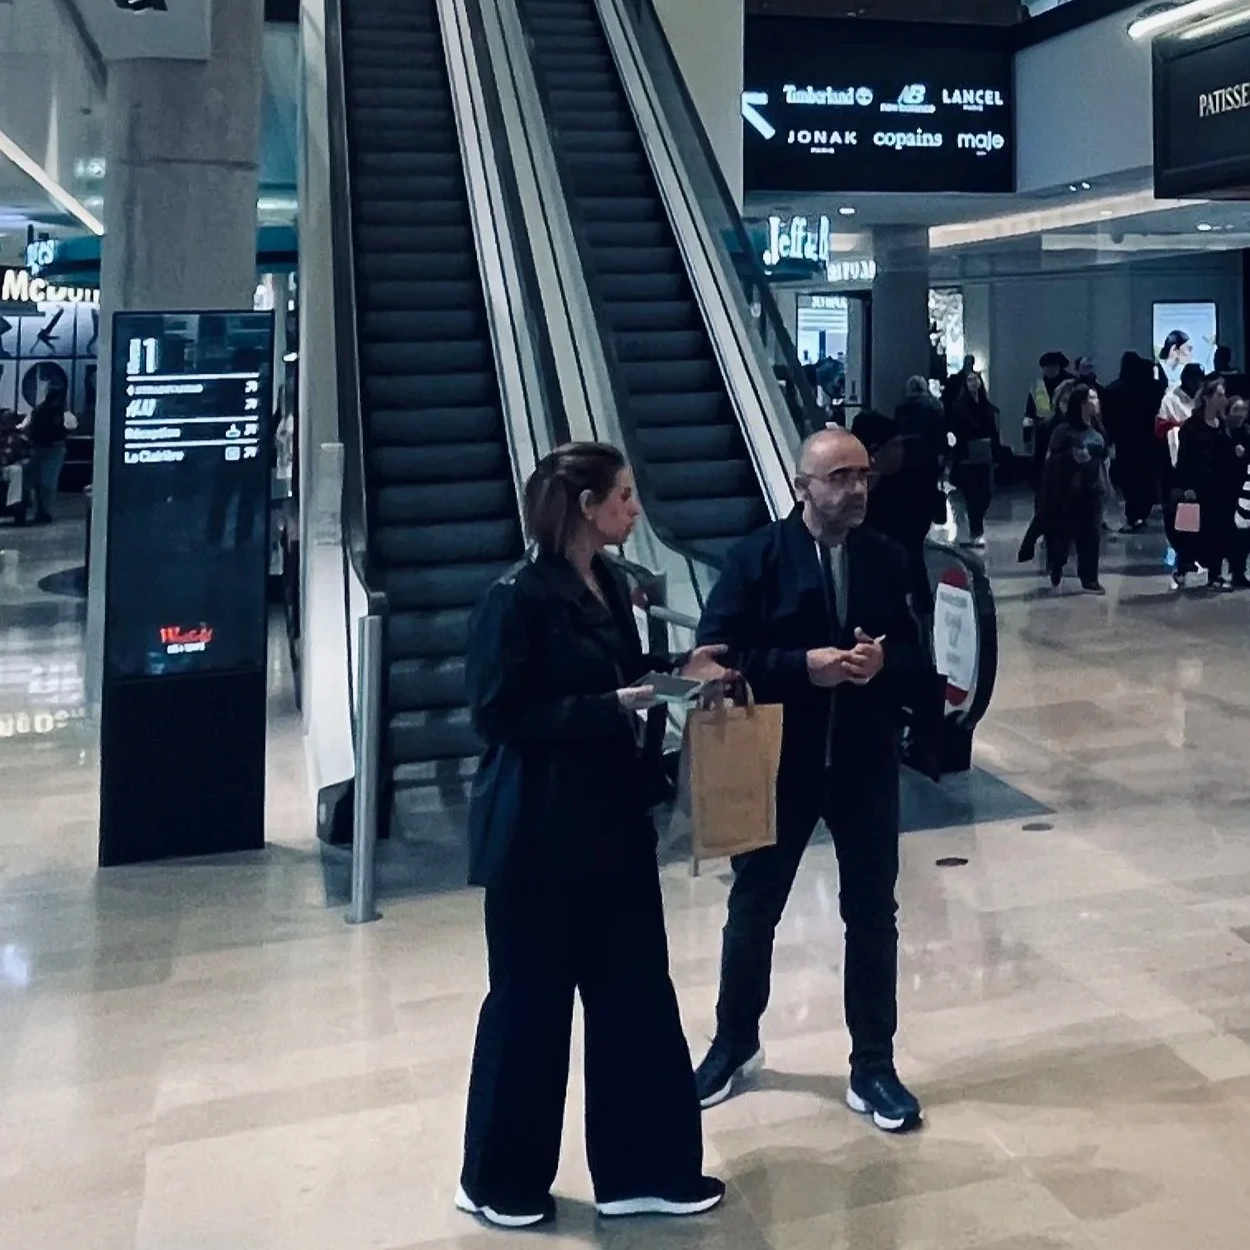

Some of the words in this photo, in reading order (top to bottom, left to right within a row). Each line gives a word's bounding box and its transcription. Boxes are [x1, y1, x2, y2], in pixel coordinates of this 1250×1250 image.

[783, 84, 854, 106] Timberland
[942, 88, 1004, 106] LANCEL
[787, 130, 857, 145] JONAK
[873, 127, 943, 150] copains
[957, 130, 1005, 151] maje
